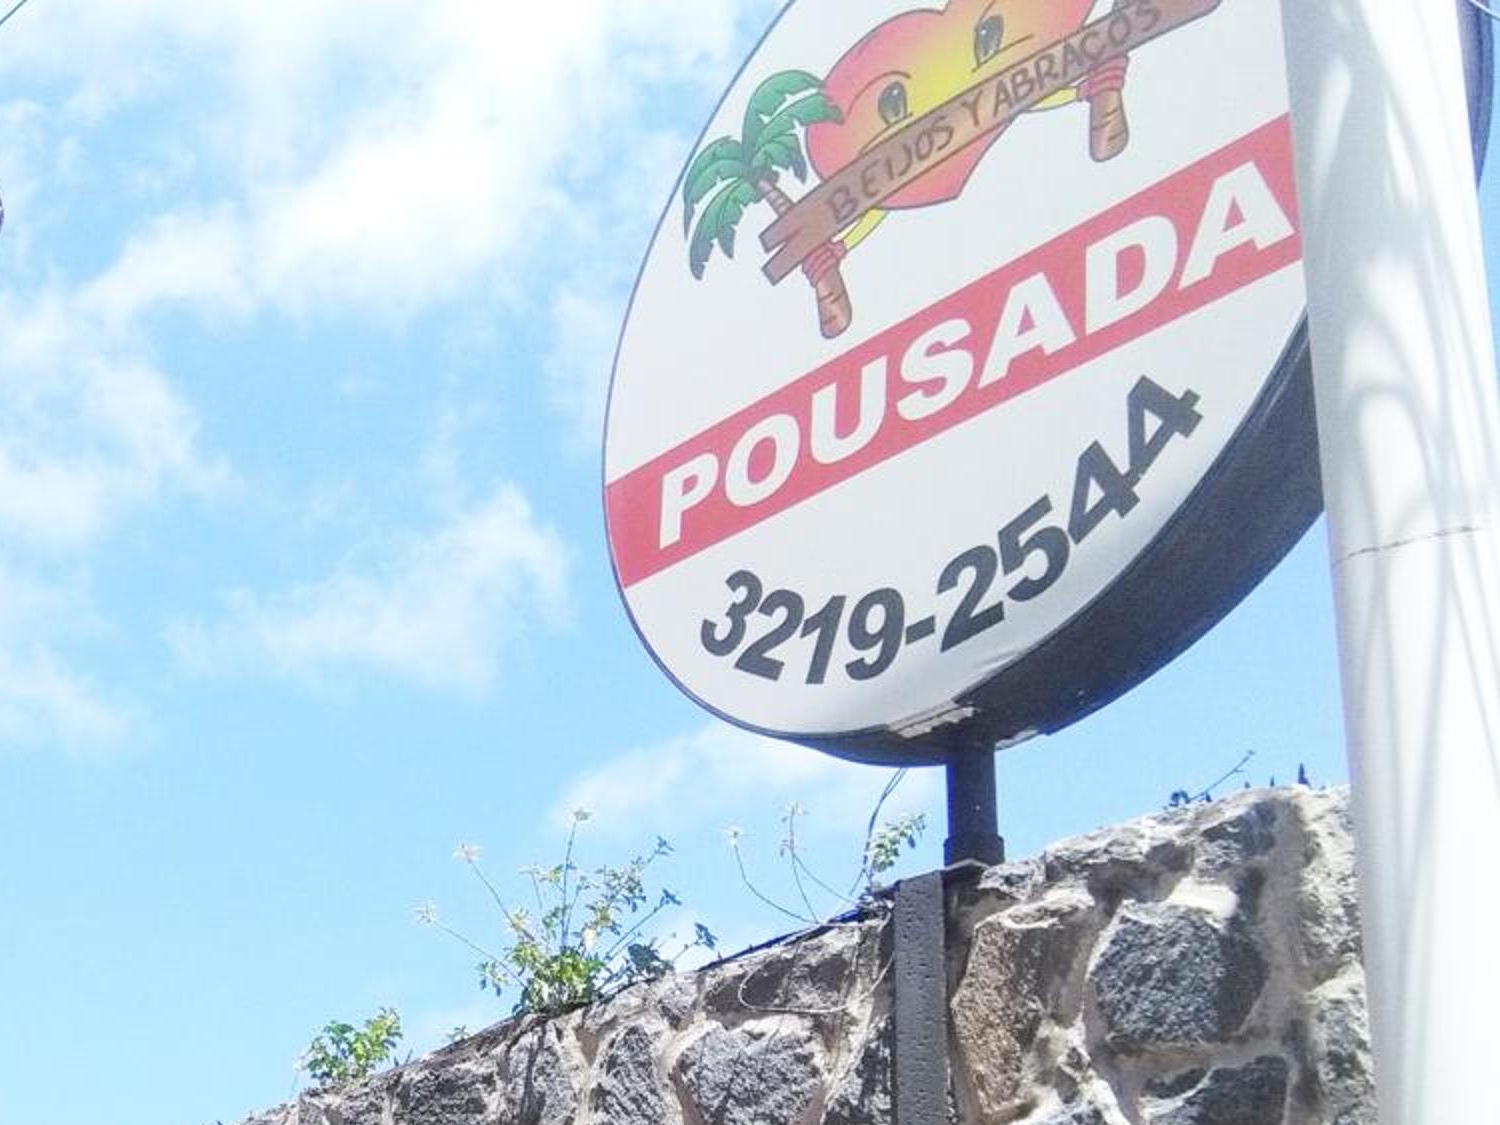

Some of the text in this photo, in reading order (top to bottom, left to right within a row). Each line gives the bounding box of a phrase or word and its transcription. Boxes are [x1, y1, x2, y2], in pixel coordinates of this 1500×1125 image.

[826, 114, 954, 223] BEIJOS
[960, 88, 984, 127] Y
[658, 160, 1296, 550] POUSADA
[702, 375, 1201, 685] 3219-2544
